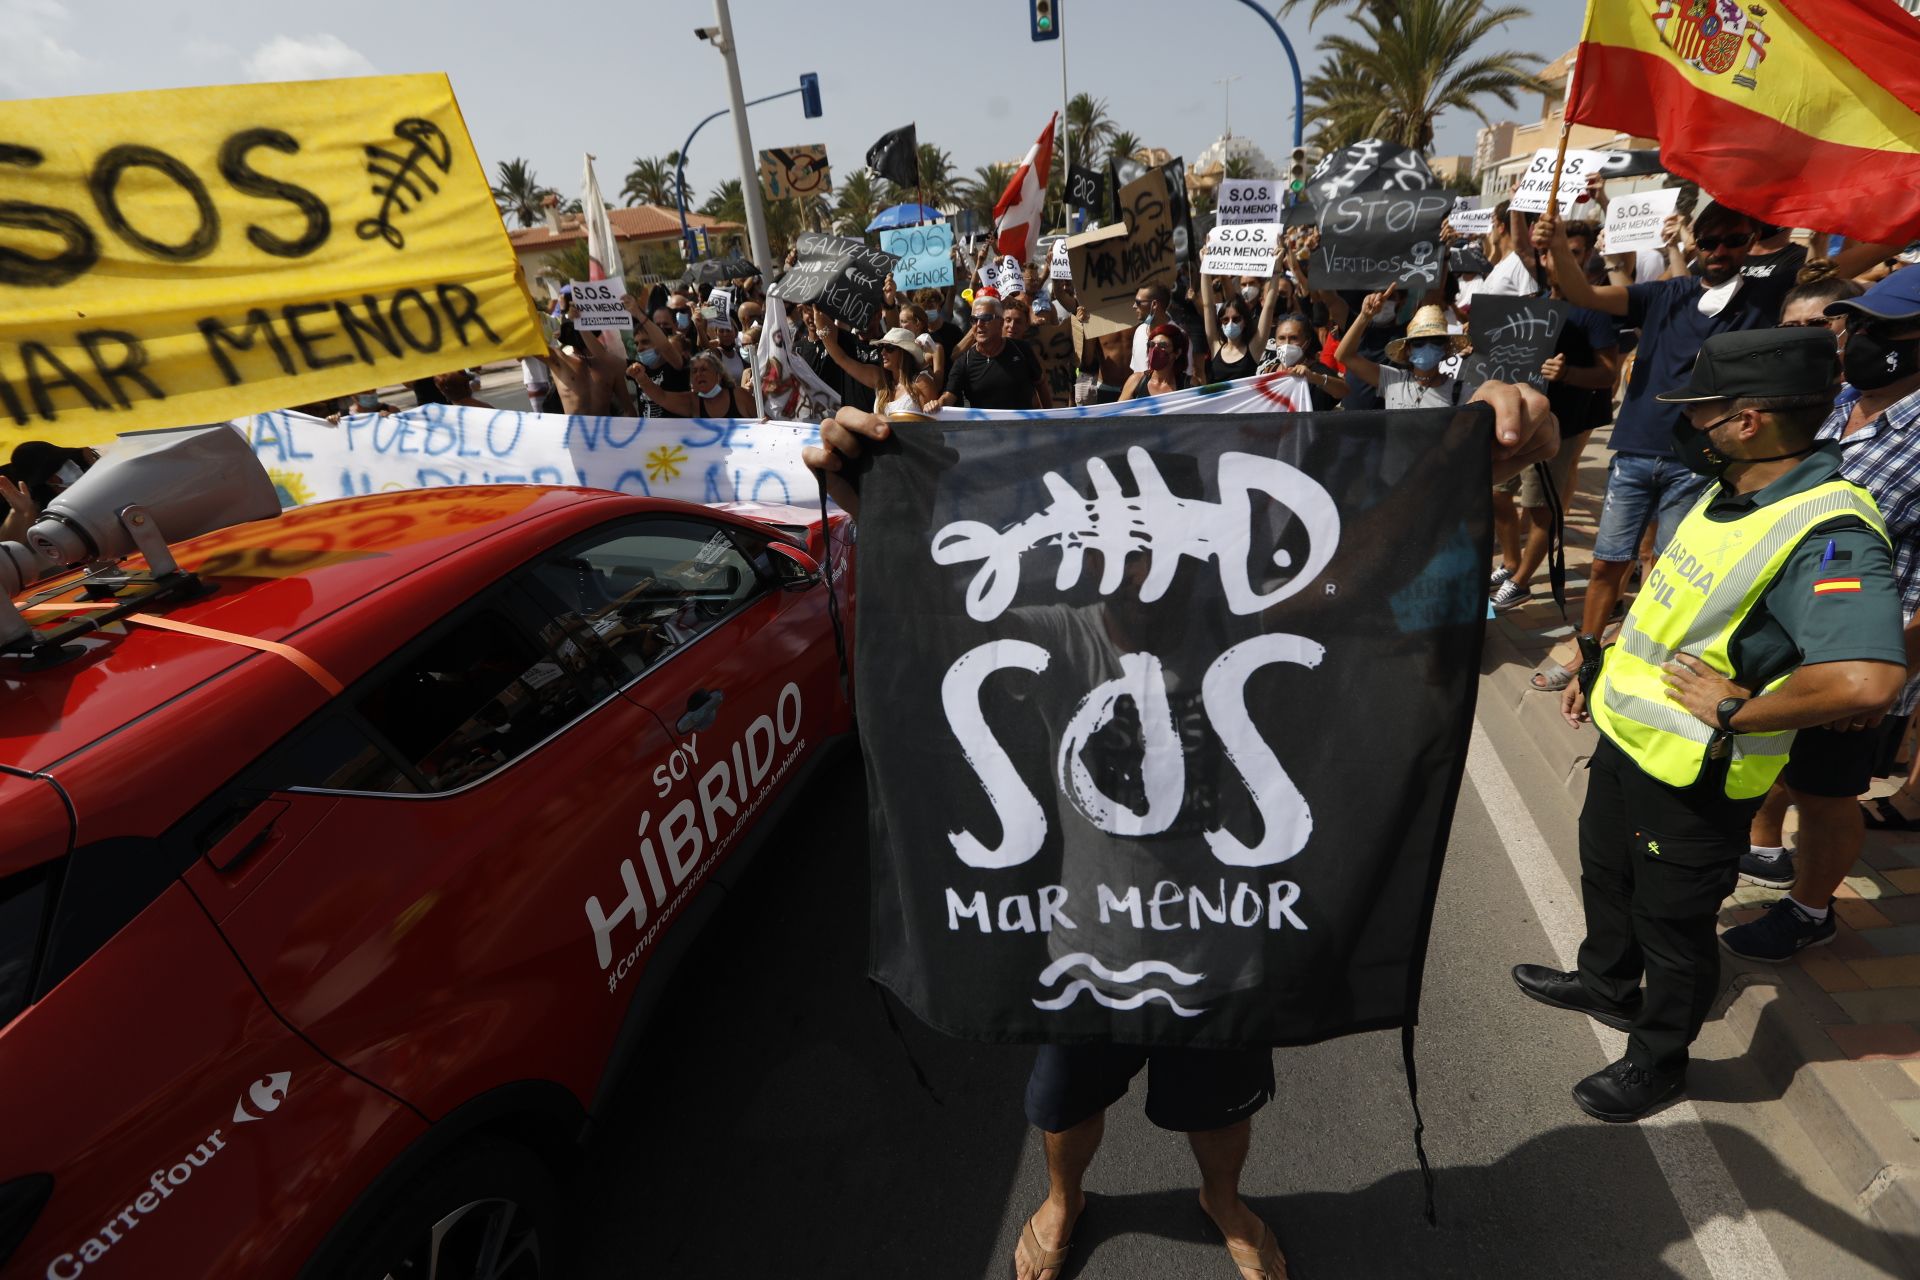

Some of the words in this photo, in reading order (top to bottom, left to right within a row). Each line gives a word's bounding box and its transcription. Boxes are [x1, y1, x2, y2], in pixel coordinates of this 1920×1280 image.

[0, 127, 331, 287] SOS
[1220, 205, 1240, 214] MAR
[1243, 204, 1278, 214] MENOR
[1229, 187, 1270, 201] S.O.S.
[1609, 223, 1626, 232] MAR
[1629, 218, 1660, 230] MENOR
[1617, 203, 1653, 218] S.O.S.
[890, 226, 946, 257] SOS
[1220, 229, 1267, 242] S.O.S.
[823, 261, 840, 272] EL
[906, 267, 949, 287] MENOR
[573, 286, 616, 300] S.O.S.
[815, 279, 872, 331] MENOR
[198, 283, 502, 385] MENOR
[255, 412, 313, 462] AL
[563, 415, 646, 451] NO
[652, 733, 699, 798] SOY
[941, 633, 1326, 869] SOS
[585, 681, 802, 970] HÍBRIDO
[46, 1128, 227, 1280] Carrefour
